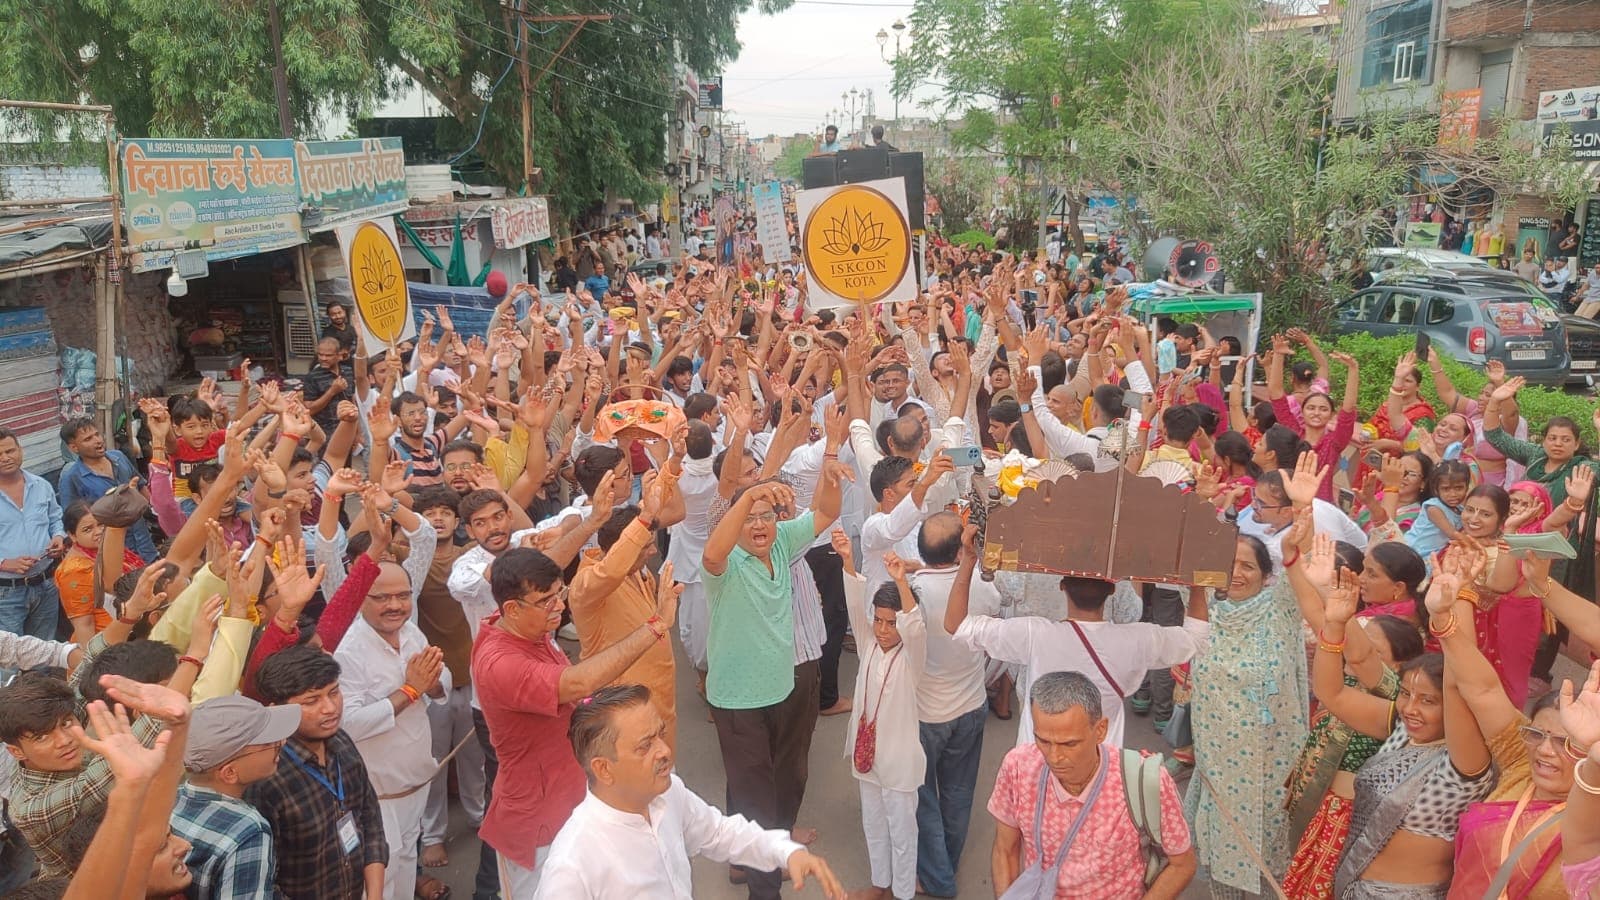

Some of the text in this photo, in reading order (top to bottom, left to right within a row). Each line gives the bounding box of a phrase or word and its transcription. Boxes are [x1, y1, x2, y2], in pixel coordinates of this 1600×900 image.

[125, 143, 295, 197] दिवाना रुई सेन्टर
[295, 141, 353, 201] दिवाना
[352, 139, 376, 192] रुई
[1520, 217, 1549, 225] KINGSON
[831, 259, 886, 275] ISKCON
[844, 276, 876, 289] KOTA
[370, 296, 399, 316] ISKCON
